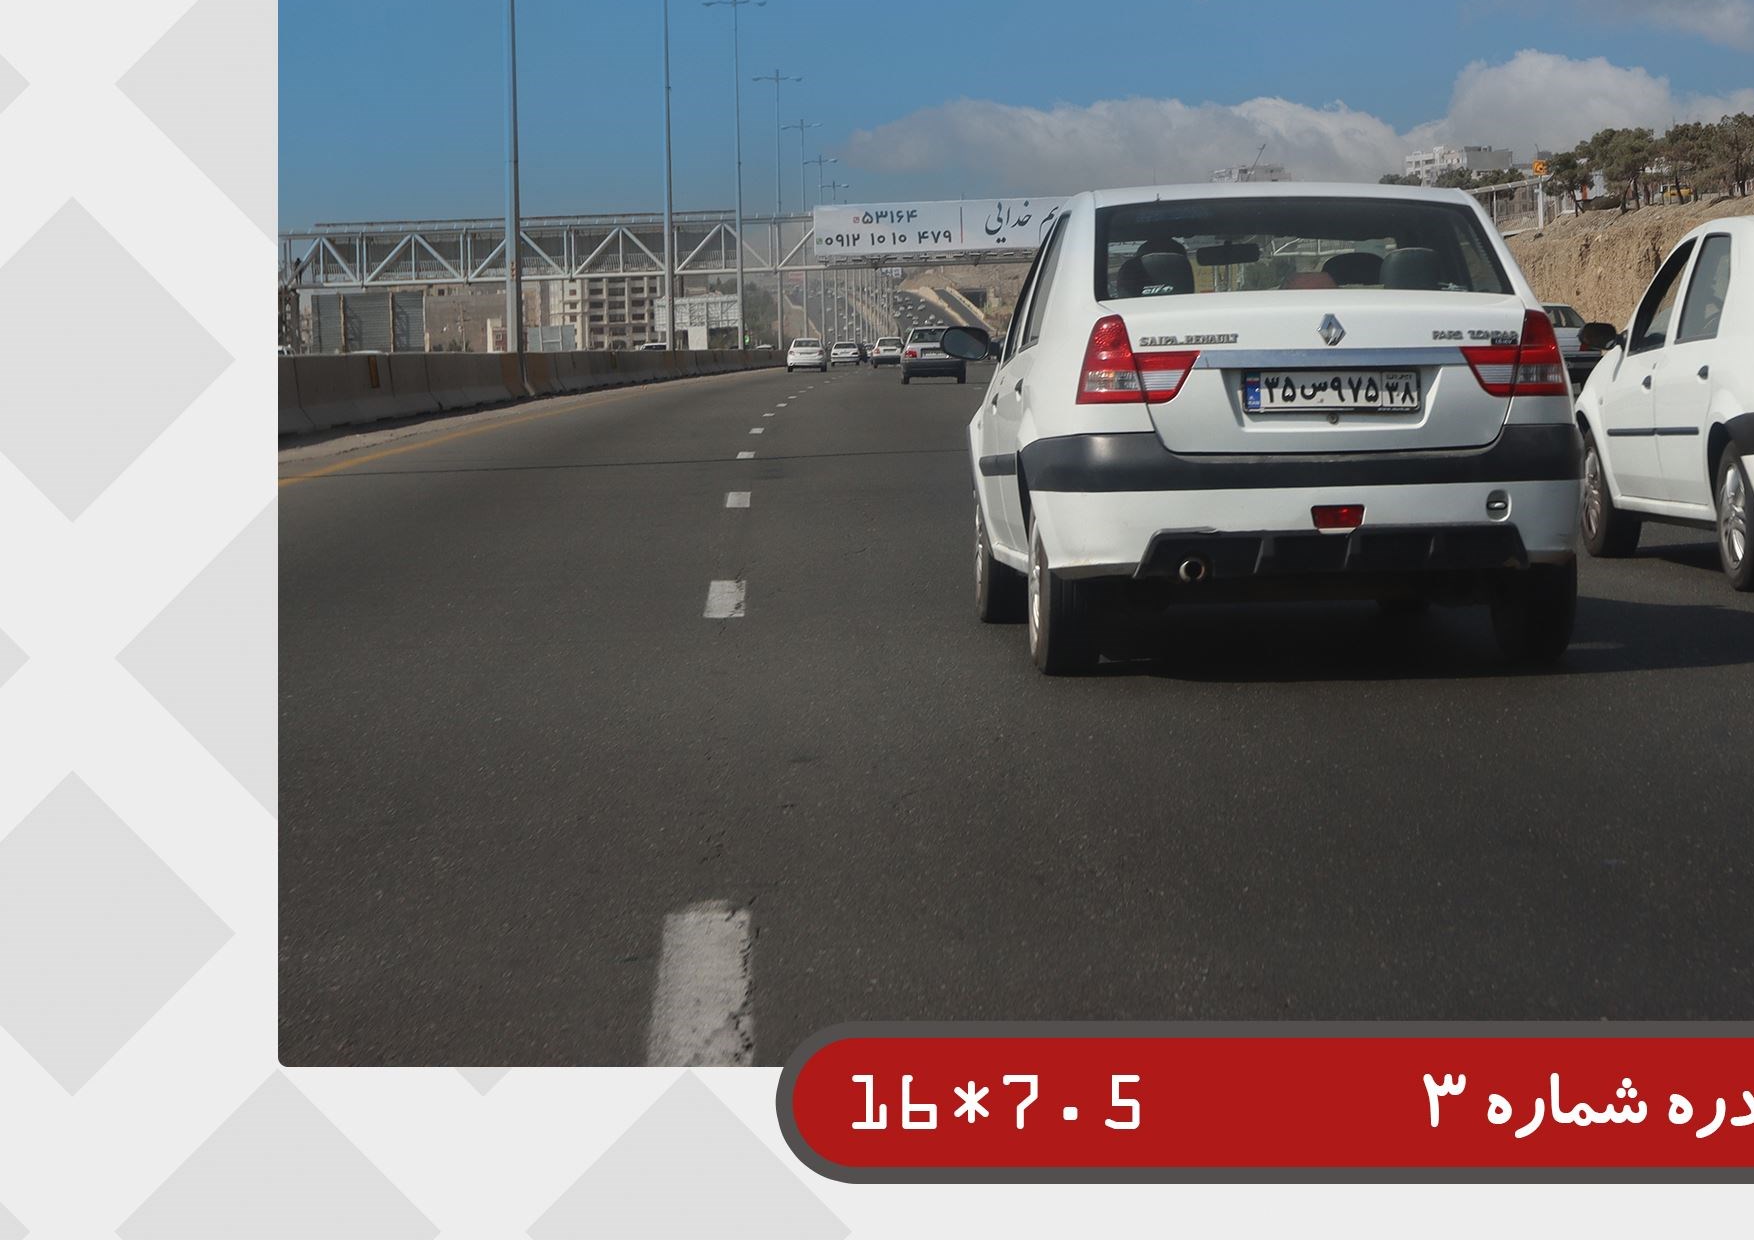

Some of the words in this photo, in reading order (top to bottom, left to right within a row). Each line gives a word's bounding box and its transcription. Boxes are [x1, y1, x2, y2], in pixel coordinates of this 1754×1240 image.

[861, 209, 918, 225] ۵۳۱۶۴
[824, 232, 861, 247] ۰۹۱۲
[871, 231, 886, 246] ۱۰
[892, 231, 907, 246] ۱۰
[917, 230, 952, 245] ۴۷۹
